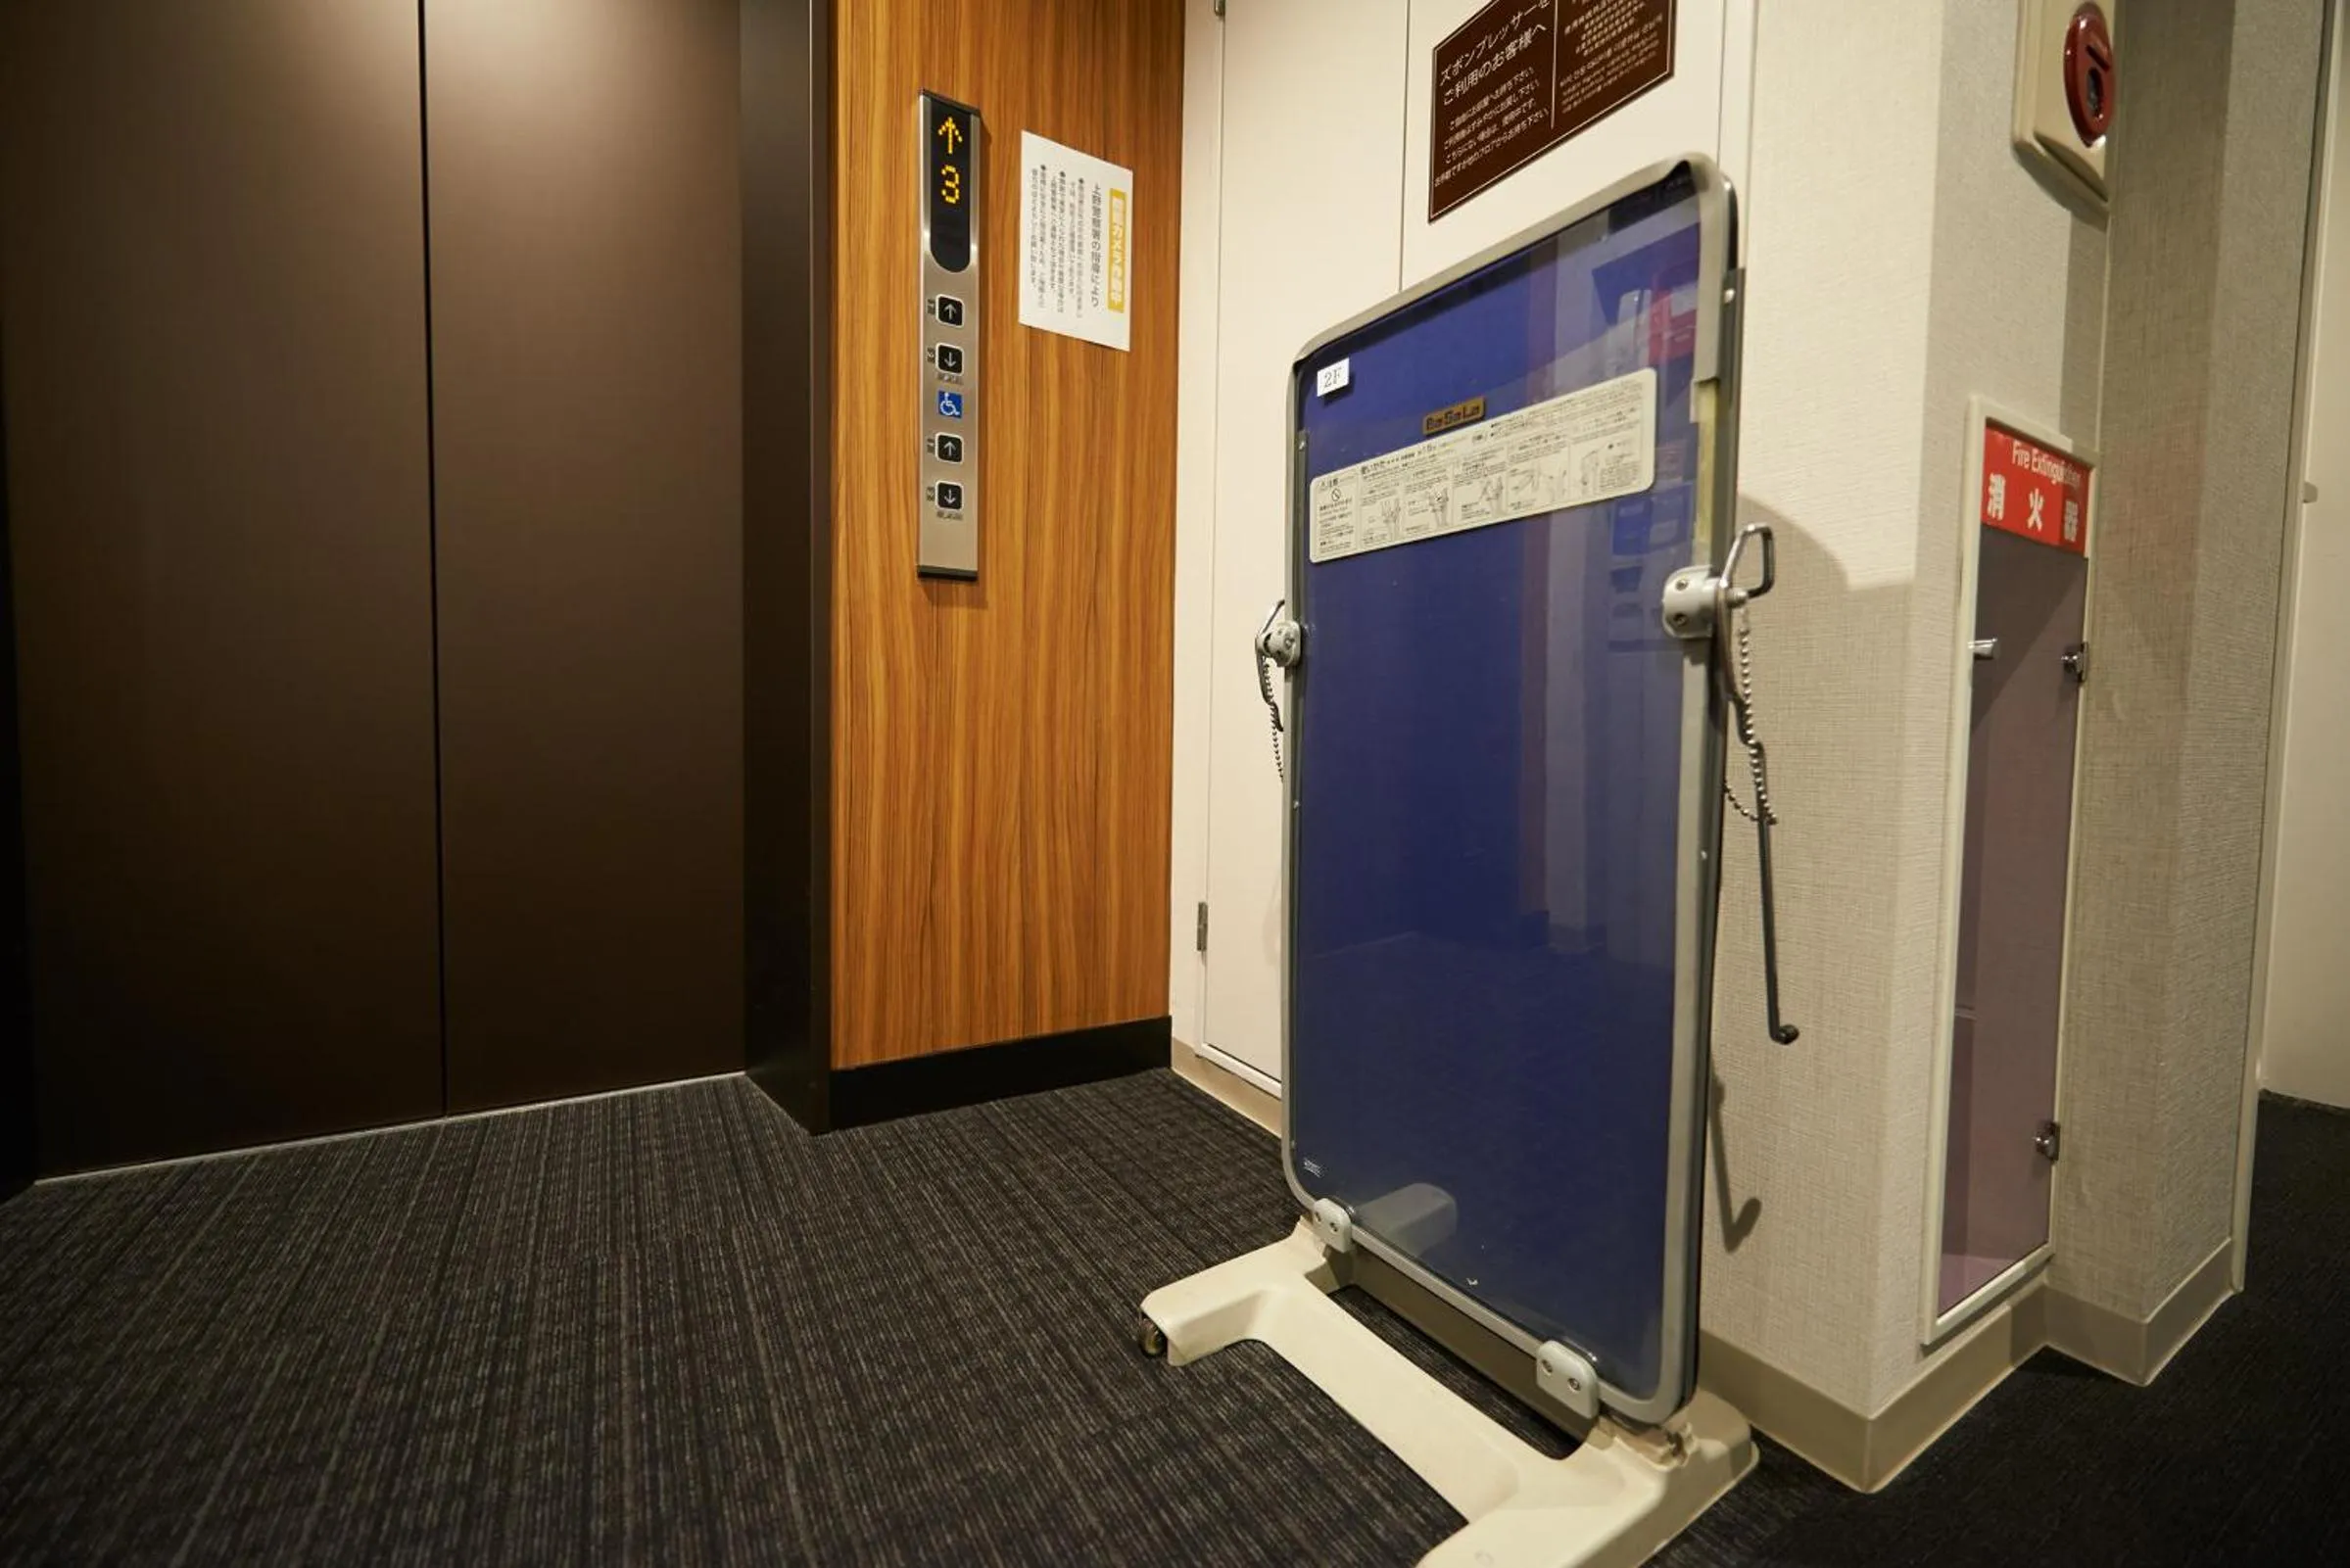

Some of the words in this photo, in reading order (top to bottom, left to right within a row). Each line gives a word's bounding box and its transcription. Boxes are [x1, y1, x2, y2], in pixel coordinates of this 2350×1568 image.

[1444, 24, 1547, 106] ご利用のお客様へ
[941, 165, 960, 204] 3
[2011, 441, 2030, 469] Fire
